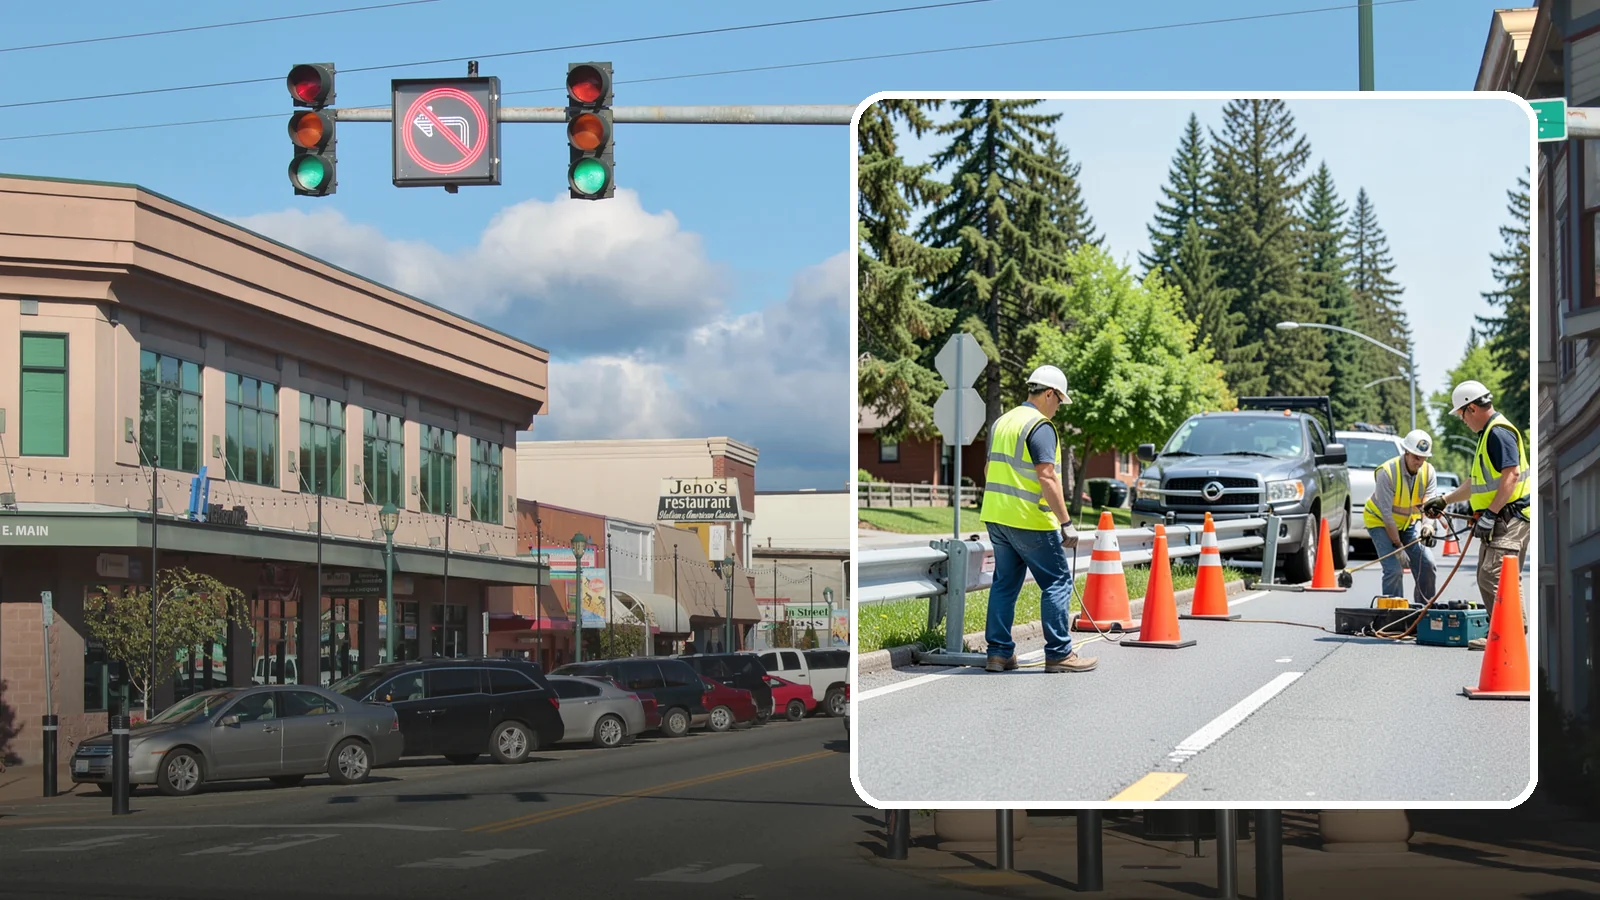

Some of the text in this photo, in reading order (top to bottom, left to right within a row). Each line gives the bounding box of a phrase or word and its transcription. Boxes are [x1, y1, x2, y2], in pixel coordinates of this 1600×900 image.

[670, 480, 727, 494] Jeno's
[665, 496, 731, 509] restaurant
[658, 510, 681, 519] Italian
[686, 510, 714, 519] American
[715, 509, 737, 519] Cuisine
[2, 525, 49, 536] E. MAIN
[797, 607, 829, 617] Street
